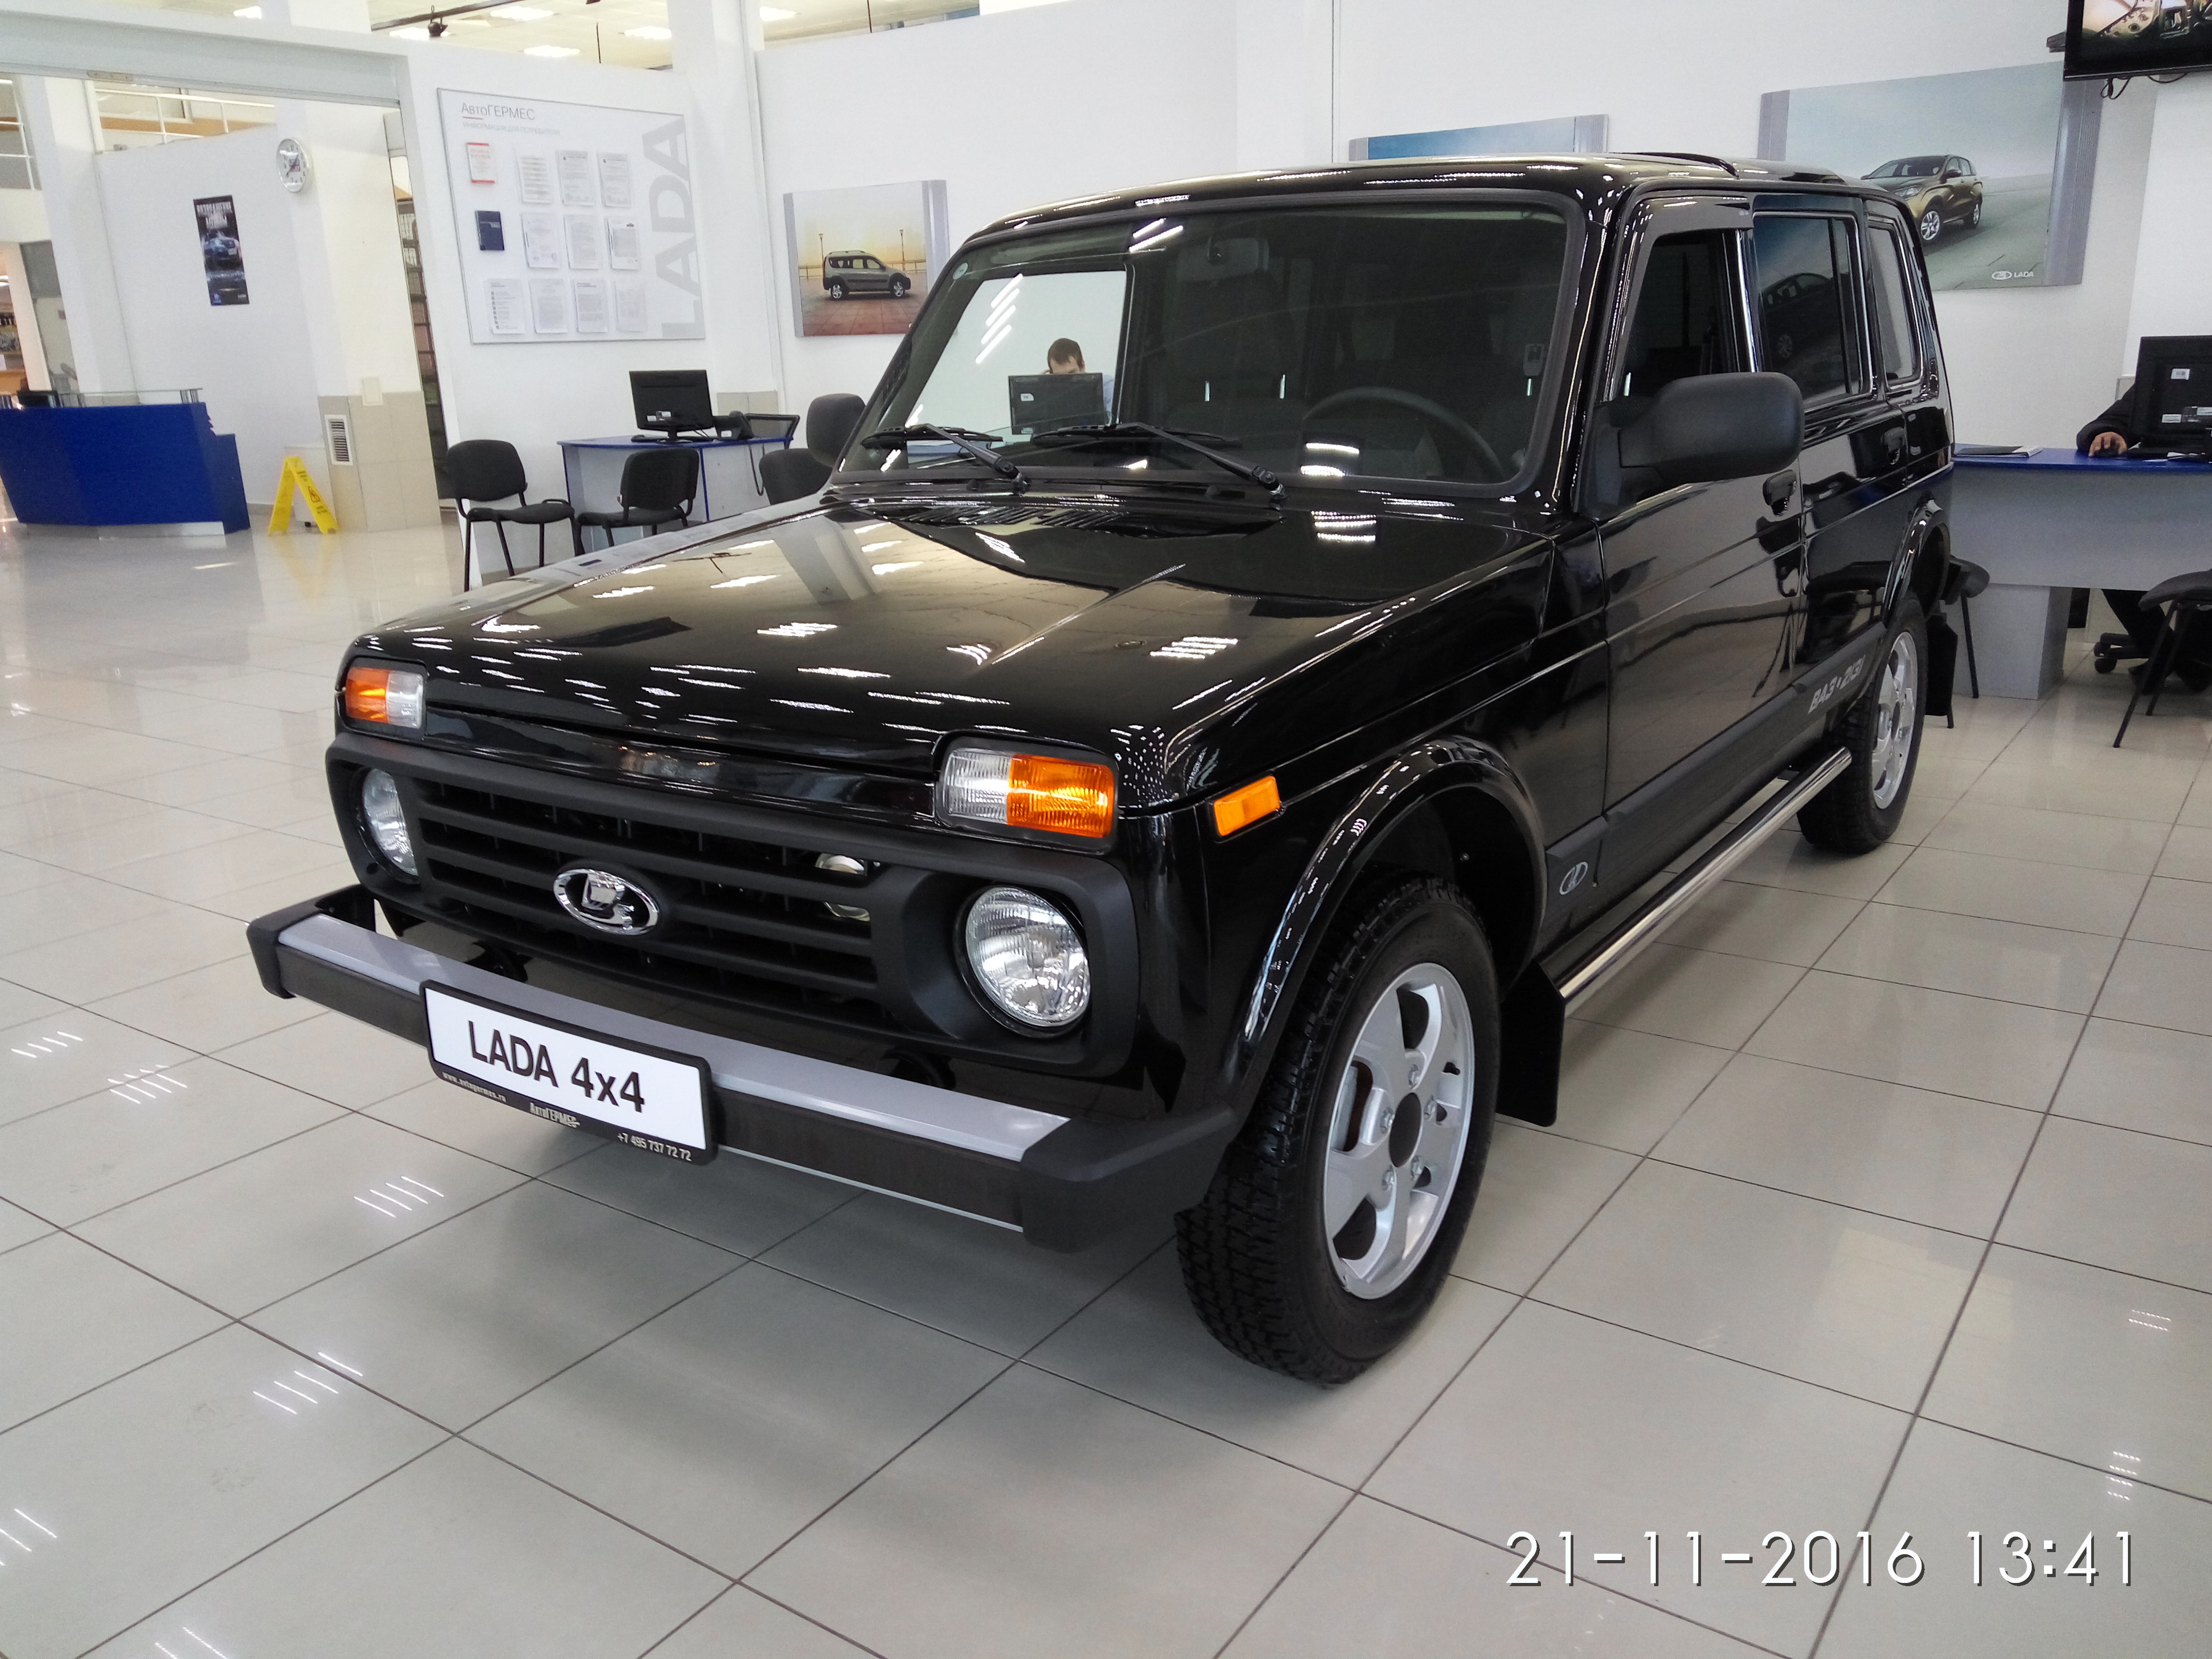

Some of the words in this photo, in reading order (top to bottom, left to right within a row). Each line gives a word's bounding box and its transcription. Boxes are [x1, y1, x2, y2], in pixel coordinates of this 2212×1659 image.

[462, 103, 535, 120] АвтоГЕРМЕС
[642, 116, 706, 339] LADA
[468, 1020, 559, 1088] LADA
[571, 1057, 644, 1113] 4x4
[617, 1133, 629, 1143] +7
[630, 1135, 647, 1149] 495
[647, 1139, 664, 1153] 737
[666, 1144, 678, 1158] 72
[679, 1148, 692, 1161] 72
